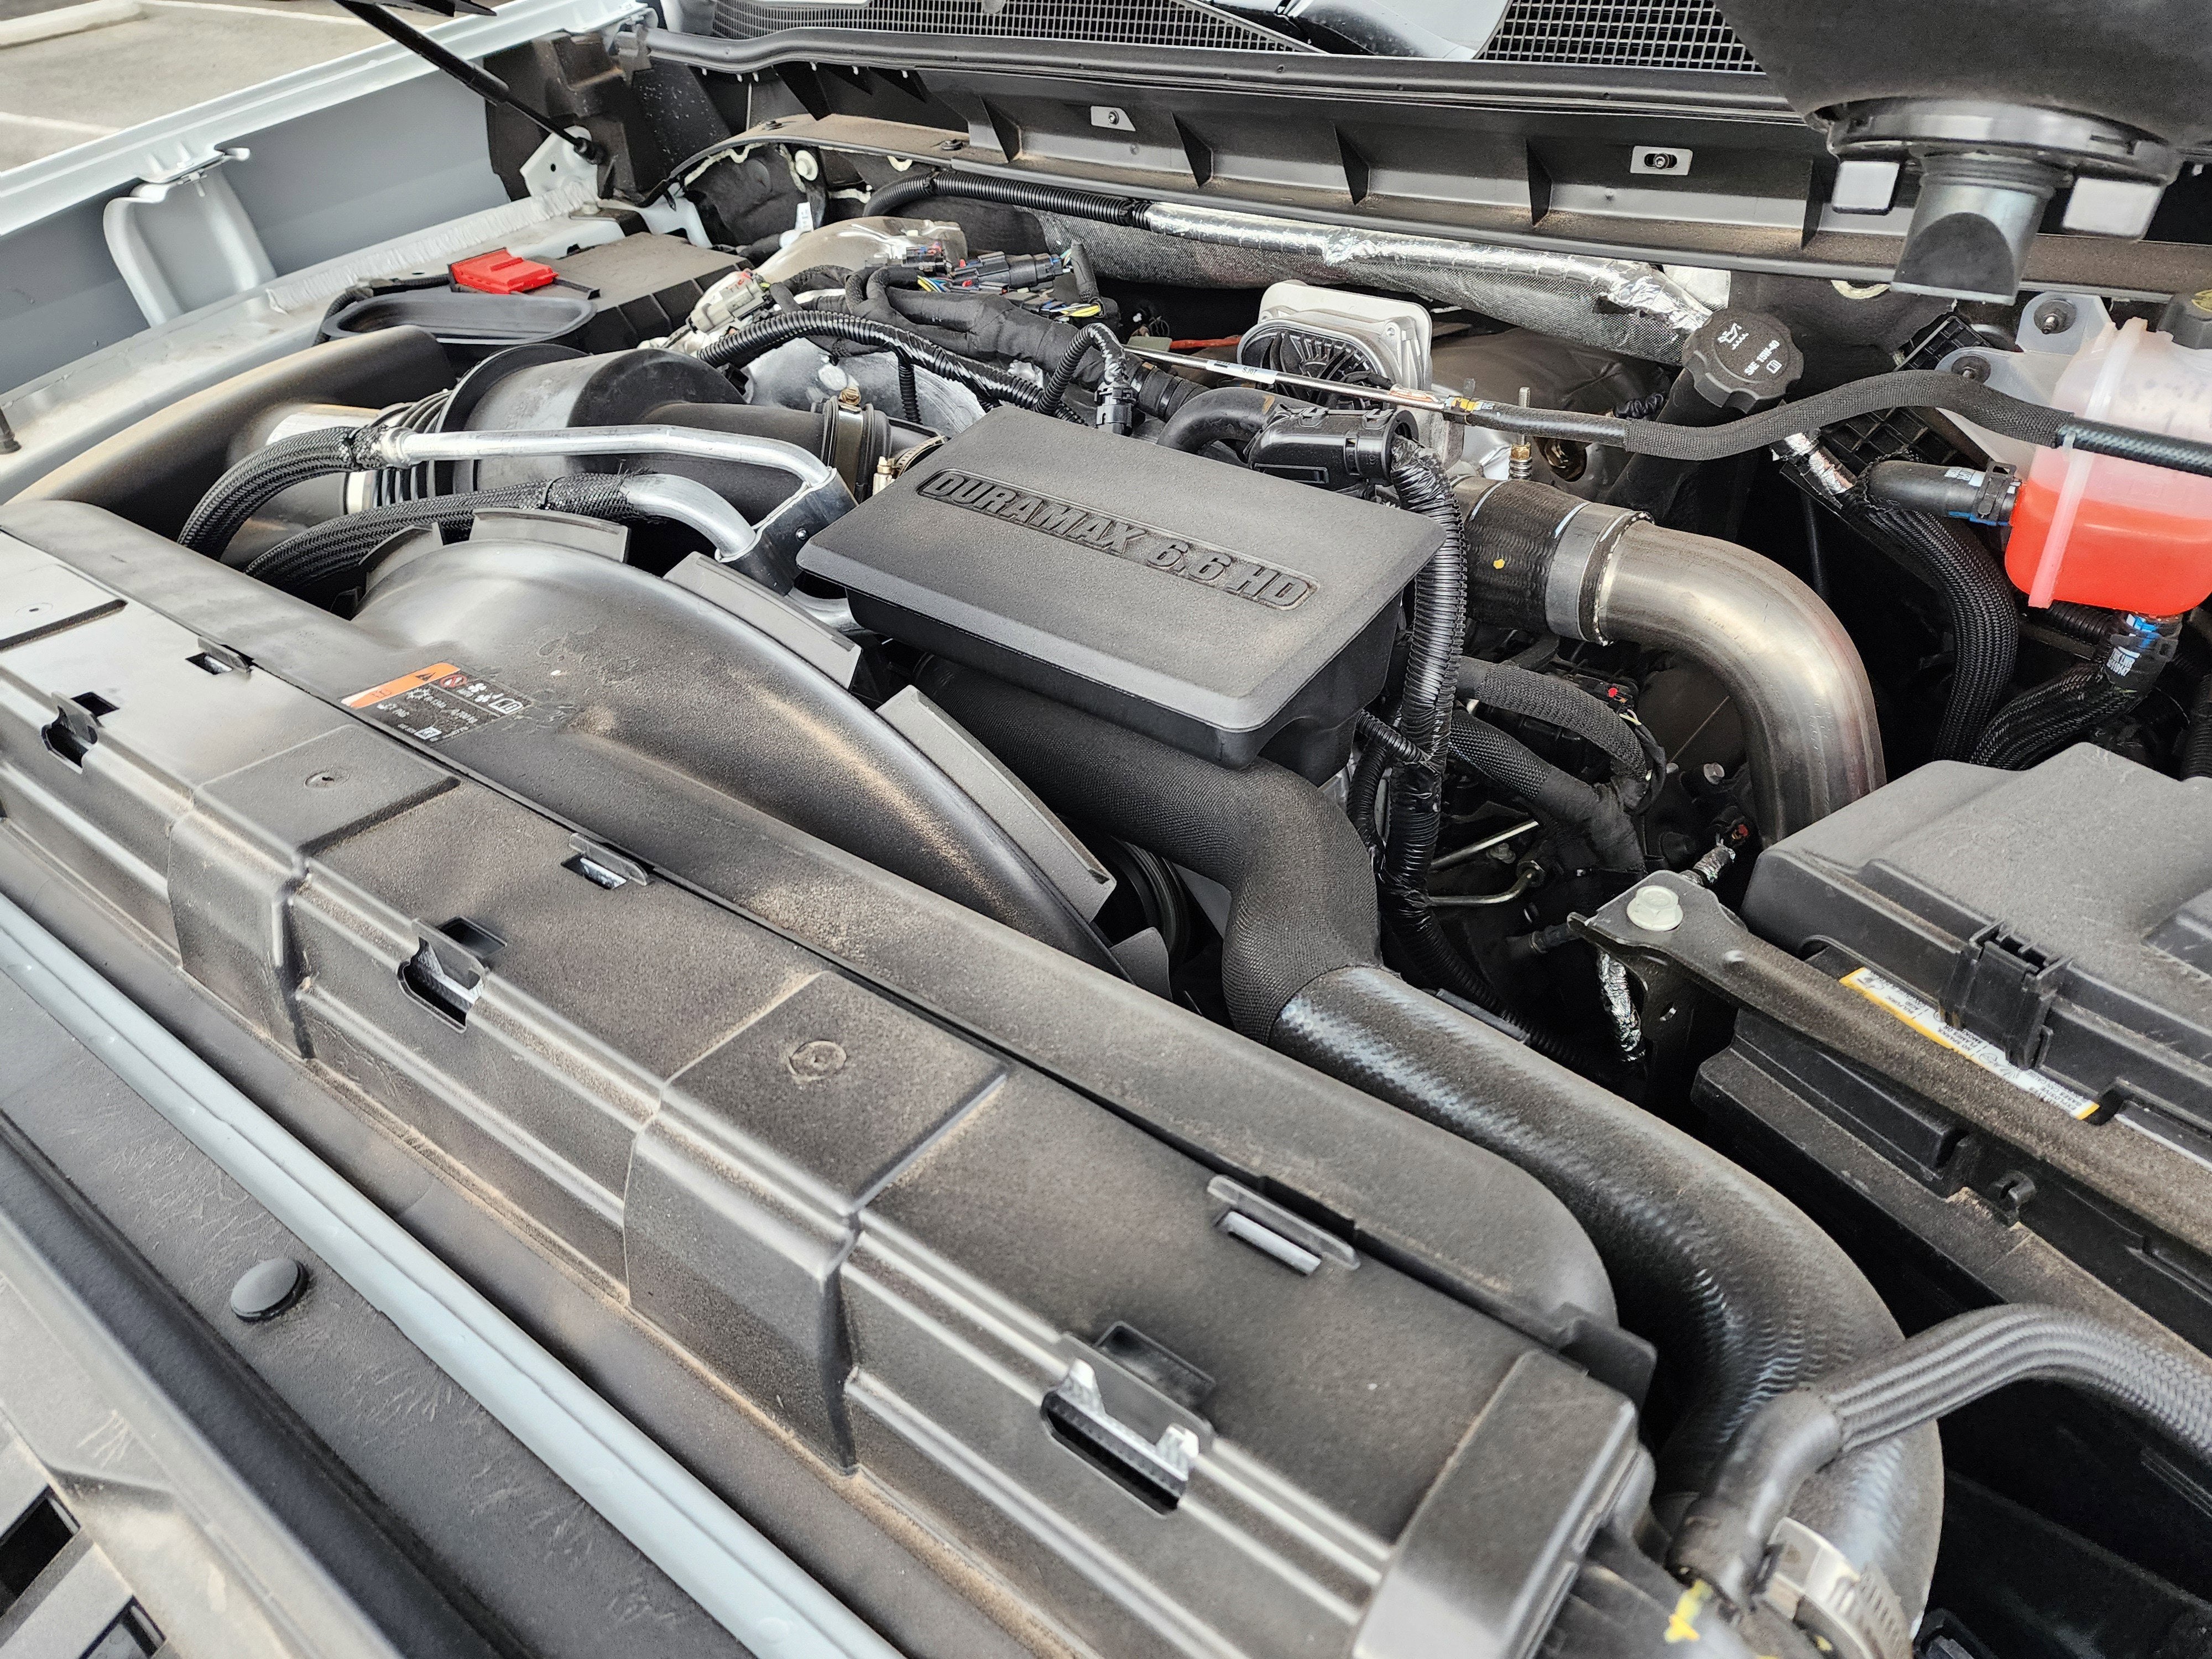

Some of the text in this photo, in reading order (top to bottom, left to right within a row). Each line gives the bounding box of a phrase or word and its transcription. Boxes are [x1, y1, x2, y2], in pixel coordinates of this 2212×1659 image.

[1242, 367, 1258, 375] SJ07
[1744, 340, 1780, 375] SAE 15W-40
[927, 472, 1311, 608] DURAMAX 6.6 HD
